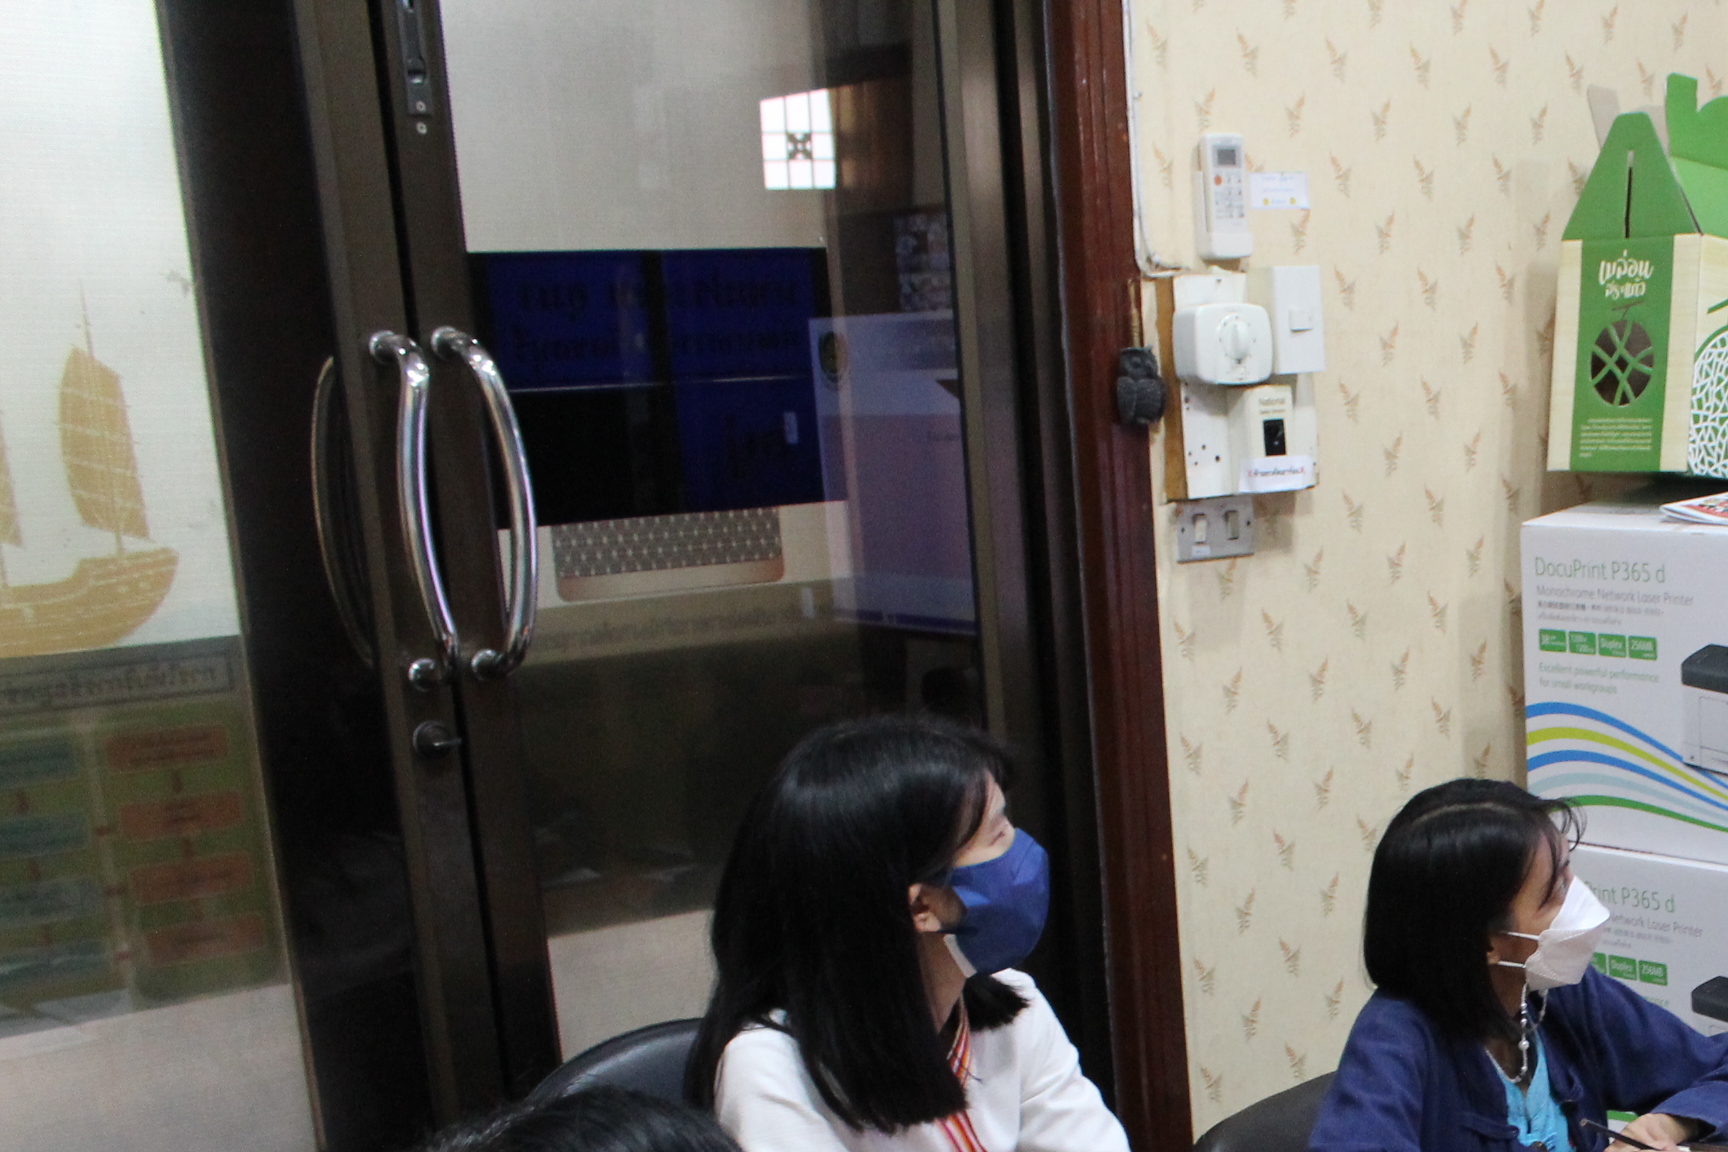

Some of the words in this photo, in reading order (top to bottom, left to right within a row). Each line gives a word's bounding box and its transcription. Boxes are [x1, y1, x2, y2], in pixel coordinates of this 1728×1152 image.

[1599, 249, 1654, 286] เมล่อน
[1534, 556, 1607, 580] DocuPrint
[1611, 560, 1651, 583] P365
[1655, 563, 1666, 583] d
[1536, 585, 1595, 600] Monochrome
[1597, 588, 1635, 603] Network
[1637, 590, 1661, 604] Laser
[1663, 592, 1694, 606] Printer
[1621, 886, 1661, 911] P365
[1665, 894, 1676, 913] d
